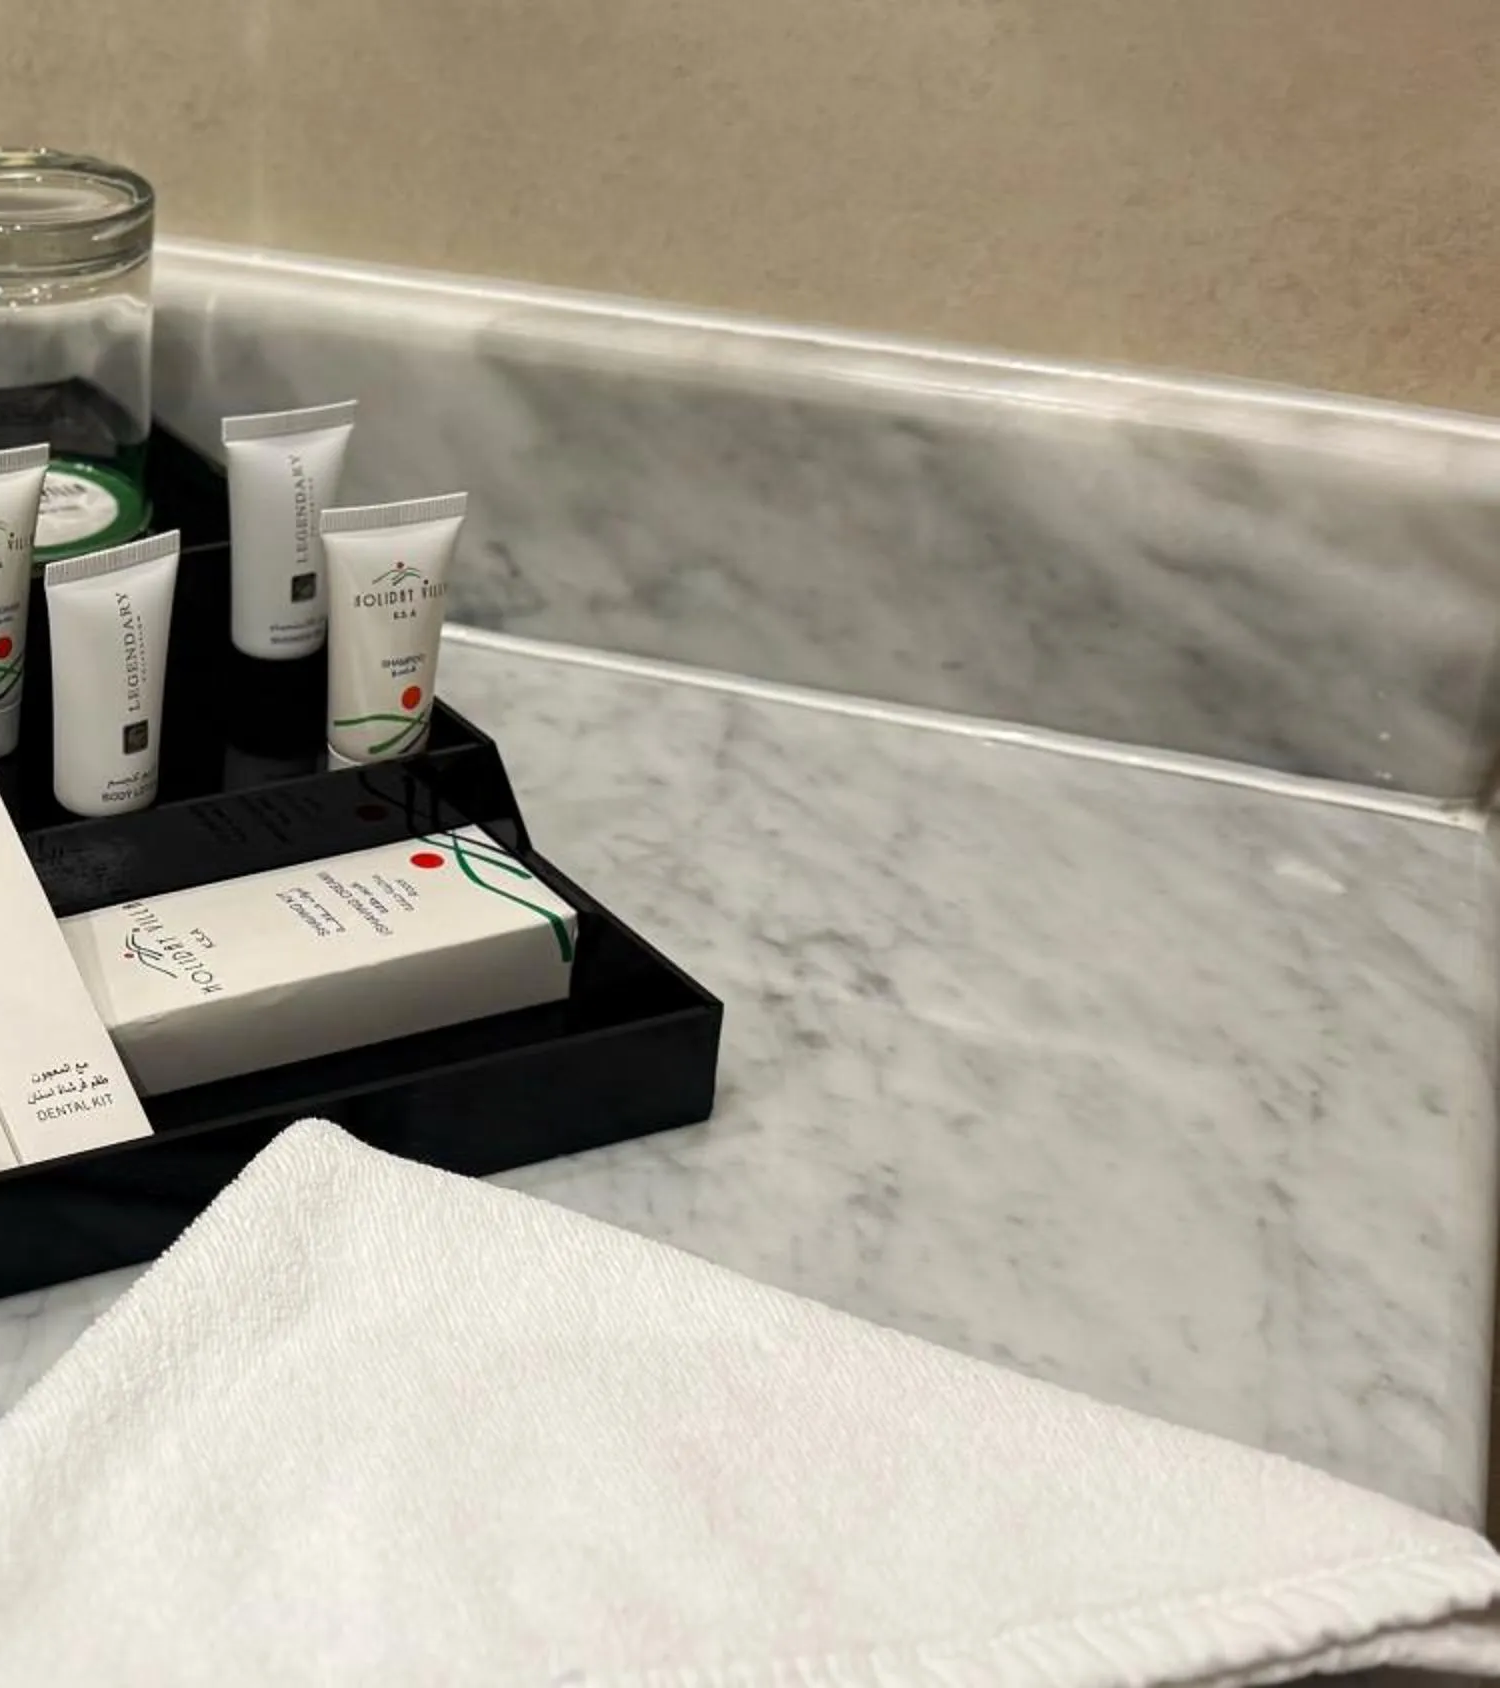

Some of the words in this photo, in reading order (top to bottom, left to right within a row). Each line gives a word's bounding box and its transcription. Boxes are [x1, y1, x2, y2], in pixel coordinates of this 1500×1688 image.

[287, 454, 308, 563] LEGENDARY
[354, 588, 414, 608] HOLIDAY
[115, 592, 141, 713] LEGENDARY
[155, 936, 224, 993] HOLIDAY
[35, 1101, 91, 1121] DENTAL
[91, 1092, 113, 1108] KIT
